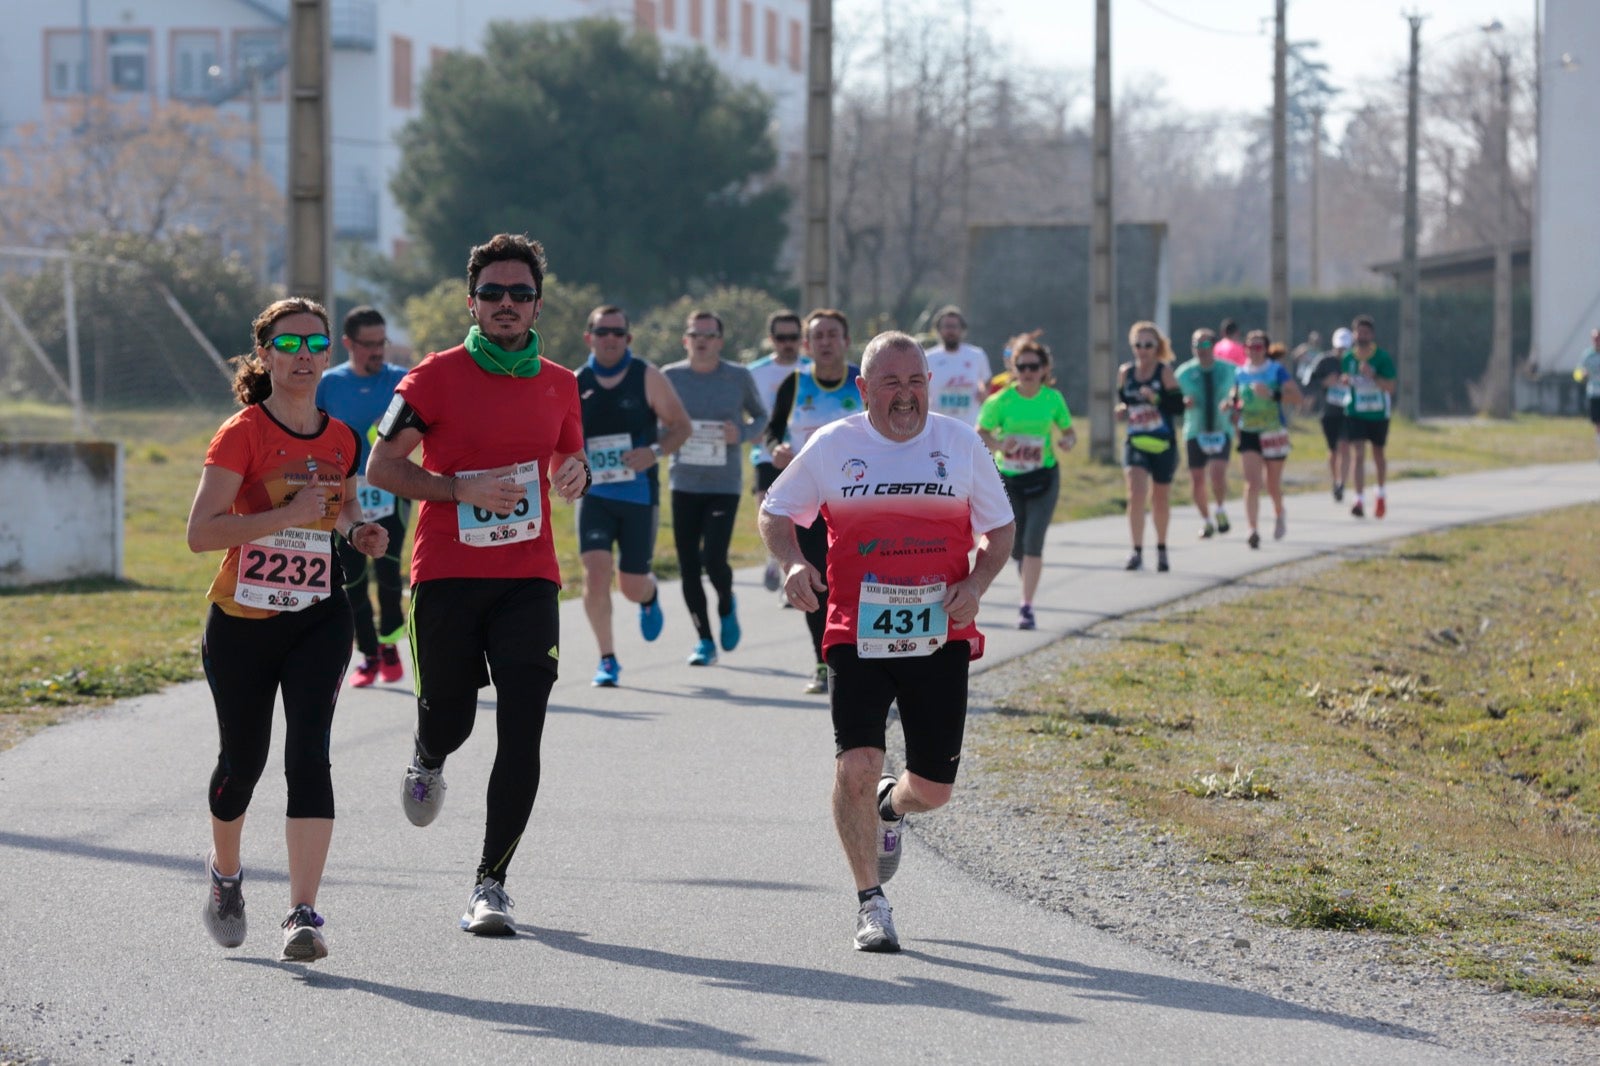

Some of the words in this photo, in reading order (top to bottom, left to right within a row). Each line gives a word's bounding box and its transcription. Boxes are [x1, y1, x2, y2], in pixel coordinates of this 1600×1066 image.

[284, 530, 304, 540] PREMIO
[880, 547, 946, 556] SEMILLEROS
[244, 550, 326, 587] 2232
[882, 586, 896, 595] GRAN
[898, 588, 918, 596] PREMIO
[873, 608, 931, 634] 431
